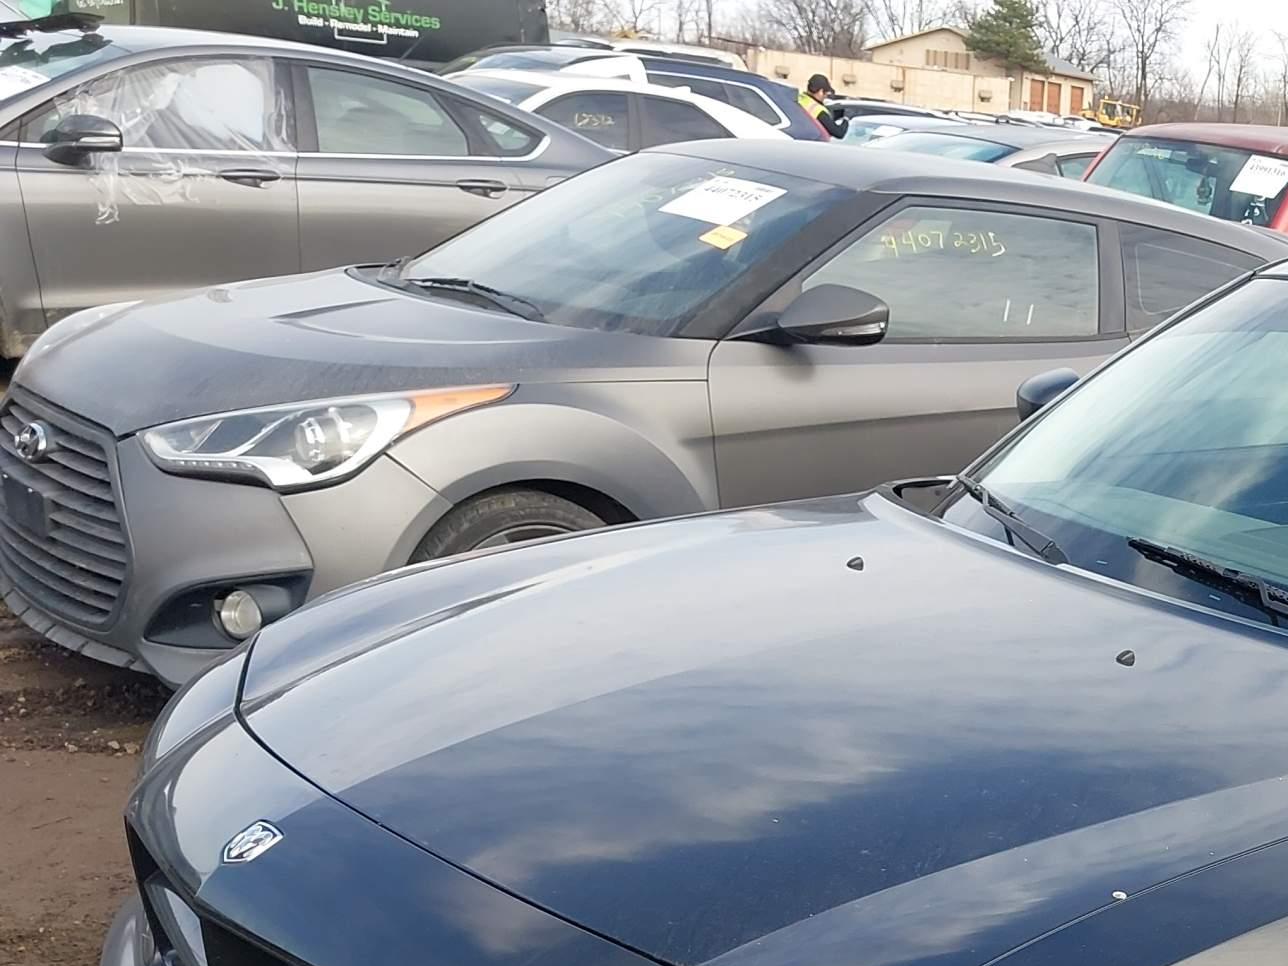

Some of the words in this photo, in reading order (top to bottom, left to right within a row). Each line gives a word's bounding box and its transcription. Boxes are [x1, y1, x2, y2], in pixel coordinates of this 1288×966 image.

[293, 0, 364, 23] Hensley
[367, 6, 441, 30] Services
[298, 15, 324, 27] Build
[329, 18, 372, 32] Remodel
[377, 25, 420, 38] Maintain
